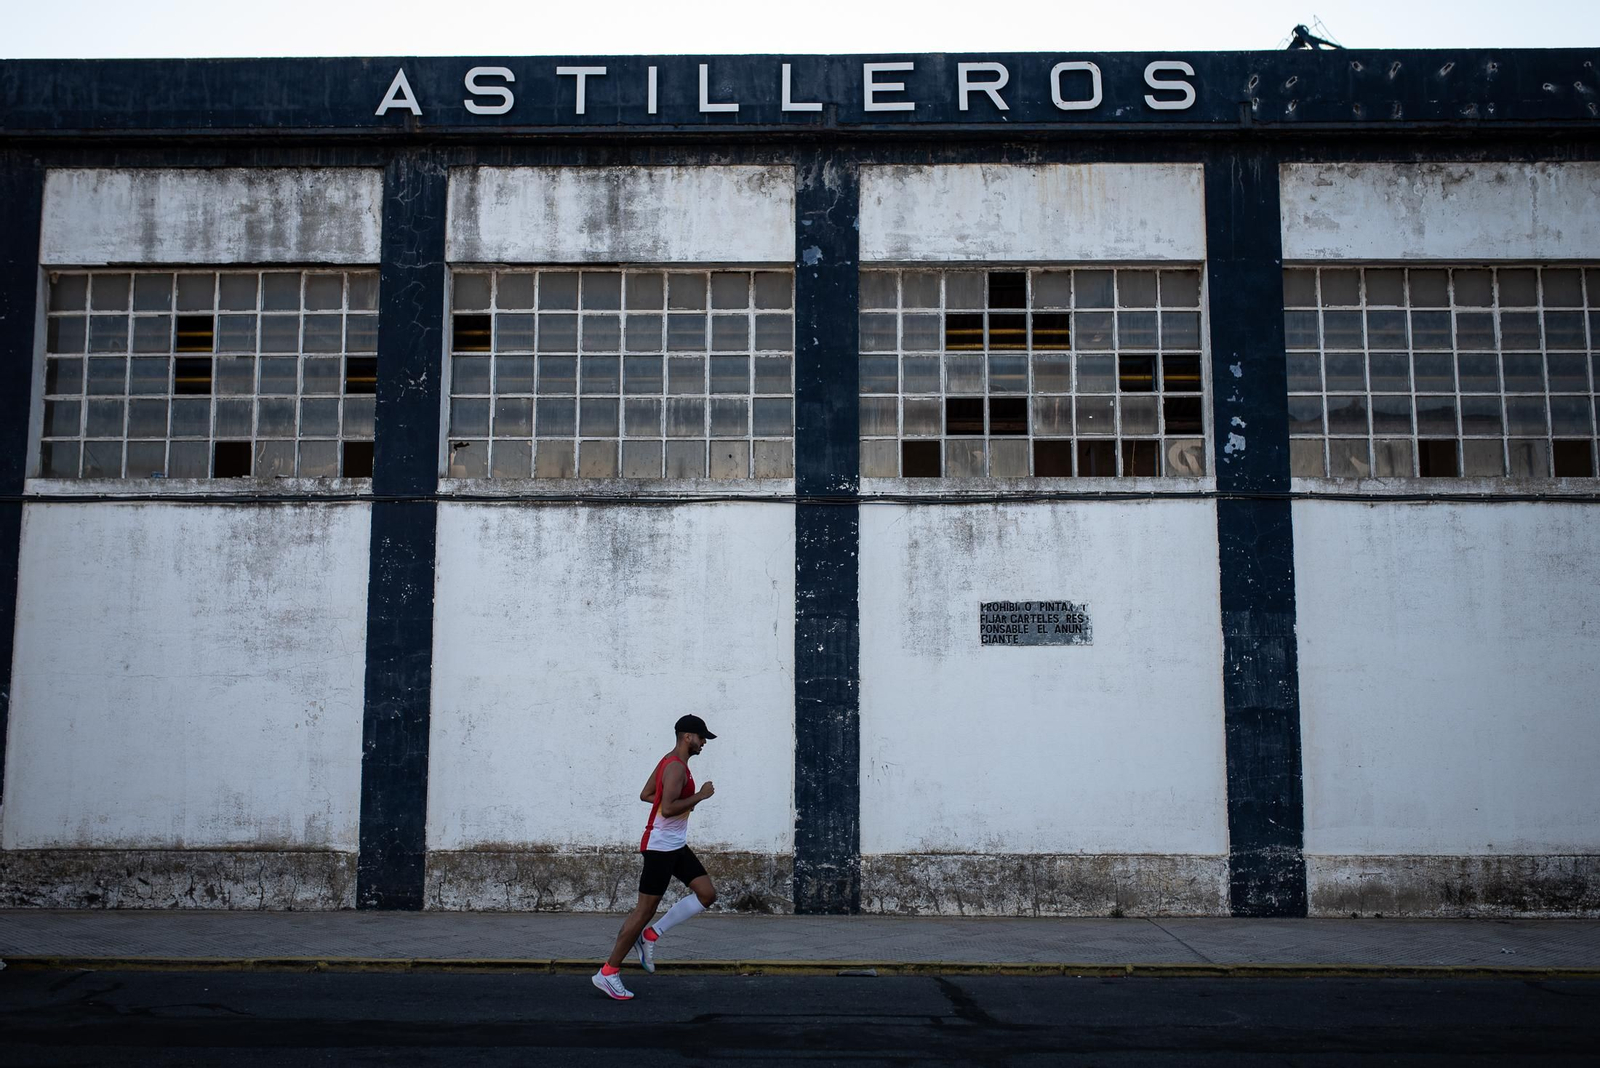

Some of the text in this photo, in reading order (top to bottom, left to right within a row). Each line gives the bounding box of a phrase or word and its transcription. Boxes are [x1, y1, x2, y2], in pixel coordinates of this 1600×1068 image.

[375, 60, 1196, 115] ASTILLEROS
[980, 614, 1010, 623] FIJAR
[1010, 614, 1059, 623] CARTELES
[980, 624, 1029, 633] PONSABLE
[1037, 624, 1048, 633] EL
